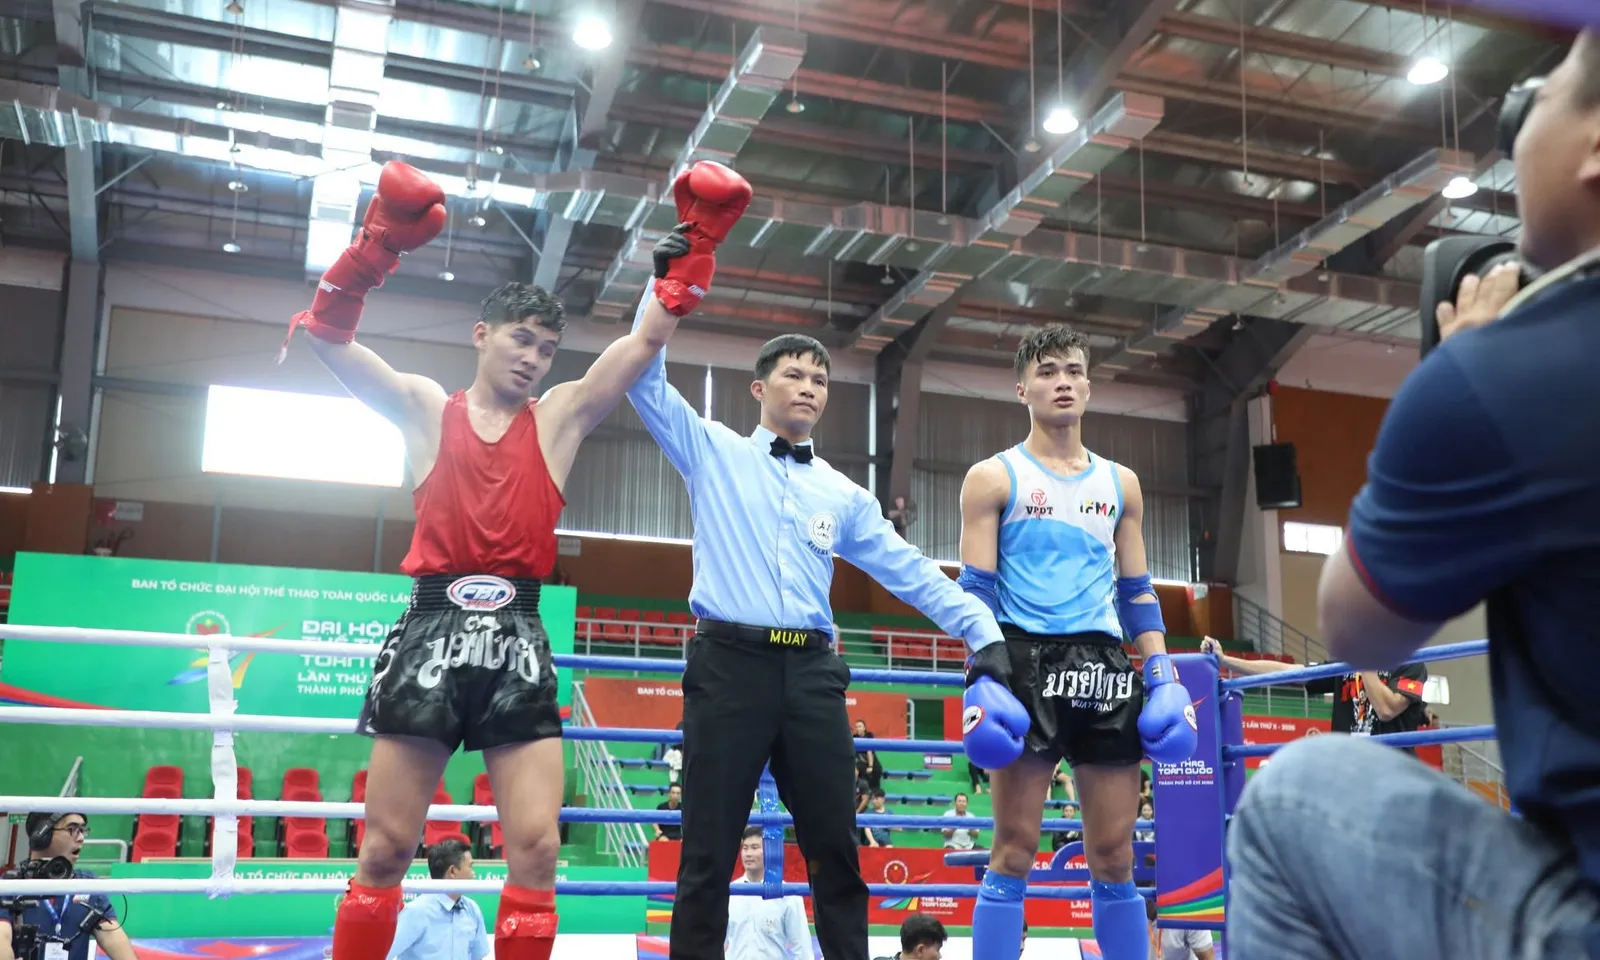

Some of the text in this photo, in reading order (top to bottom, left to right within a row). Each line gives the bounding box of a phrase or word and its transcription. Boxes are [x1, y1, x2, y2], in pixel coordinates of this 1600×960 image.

[1026, 505, 1054, 516] VPDT
[131, 578, 158, 589] BAN
[161, 578, 177, 591] TỔ
[179, 580, 213, 593] CHỨC
[215, 584, 236, 595] ĐẠI
[239, 584, 260, 598] HỘI
[288, 588, 319, 599] THAO
[322, 589, 353, 601] TOÀN
[355, 590, 387, 603] QUỐC
[302, 620, 342, 636] ĐẠI
[348, 620, 390, 639] HỘI
[769, 629, 808, 646] MUAY
[335, 672, 368, 684] THỨ
[1042, 661, 1135, 700] มวยไทย
[297, 684, 365, 696] THÀNH PHỐ
[637, 687, 654, 695] BAN
